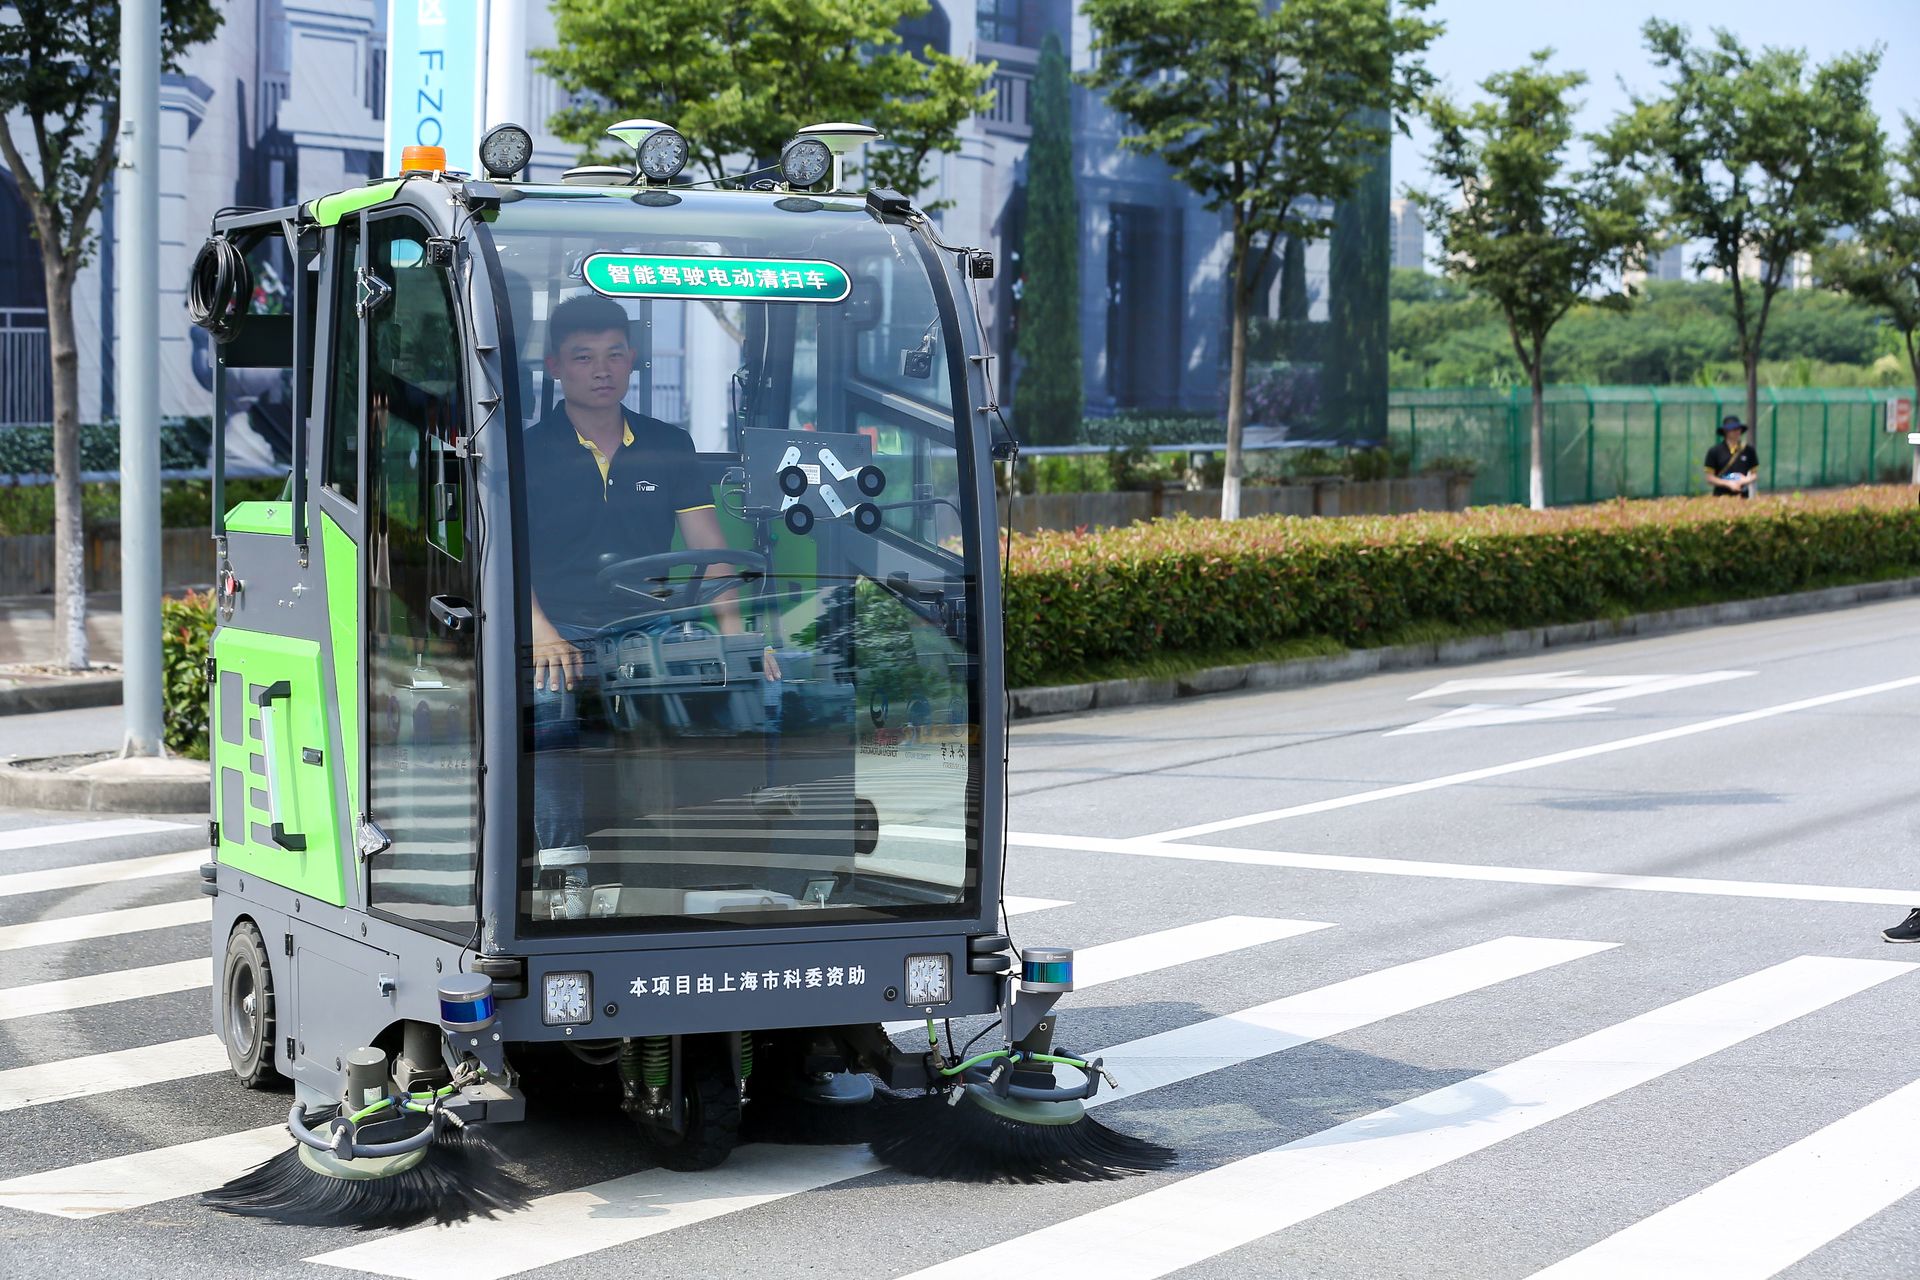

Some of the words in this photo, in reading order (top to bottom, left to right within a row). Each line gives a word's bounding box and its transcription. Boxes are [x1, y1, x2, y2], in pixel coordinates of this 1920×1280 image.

[607, 264, 828, 290] 智能驾驶电动清扫车
[629, 965, 866, 998] 本项目由上海市科委资助
